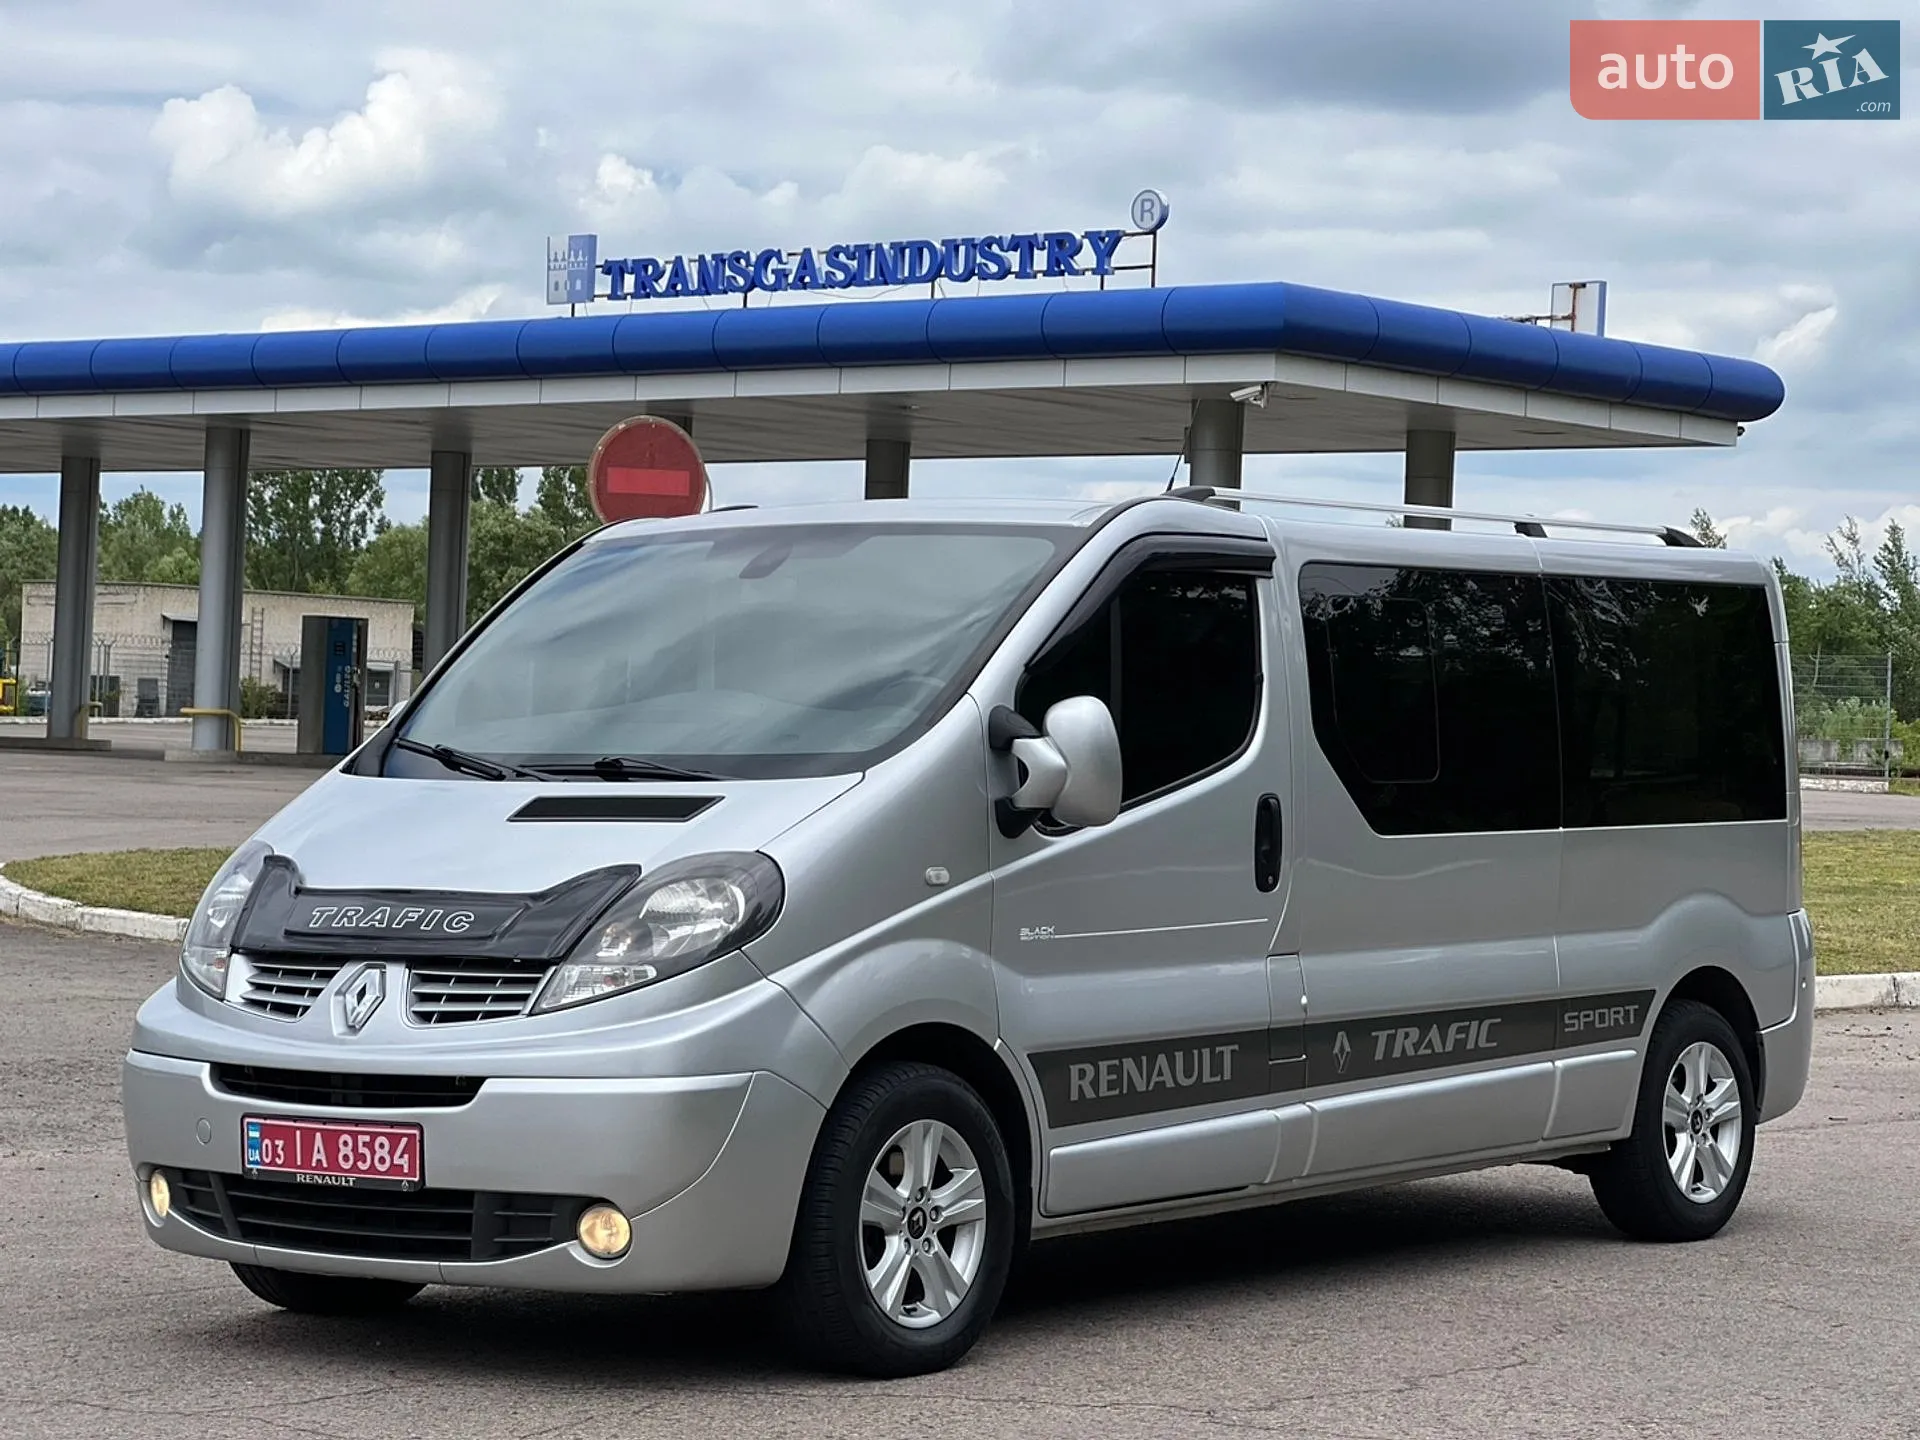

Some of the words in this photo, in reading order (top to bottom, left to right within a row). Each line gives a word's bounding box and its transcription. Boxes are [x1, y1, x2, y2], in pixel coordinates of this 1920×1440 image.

[600, 229, 1126, 301] TRANSGASINDUSTRY
[309, 906, 476, 933] TRAFIC
[1069, 1043, 1239, 1101] RENAULT
[1371, 1018, 1502, 1062] TRAFIC
[1563, 1004, 1640, 1033] SPORT
[337, 1133, 410, 1174] 8584
[296, 1173, 357, 1187] RENAULT
